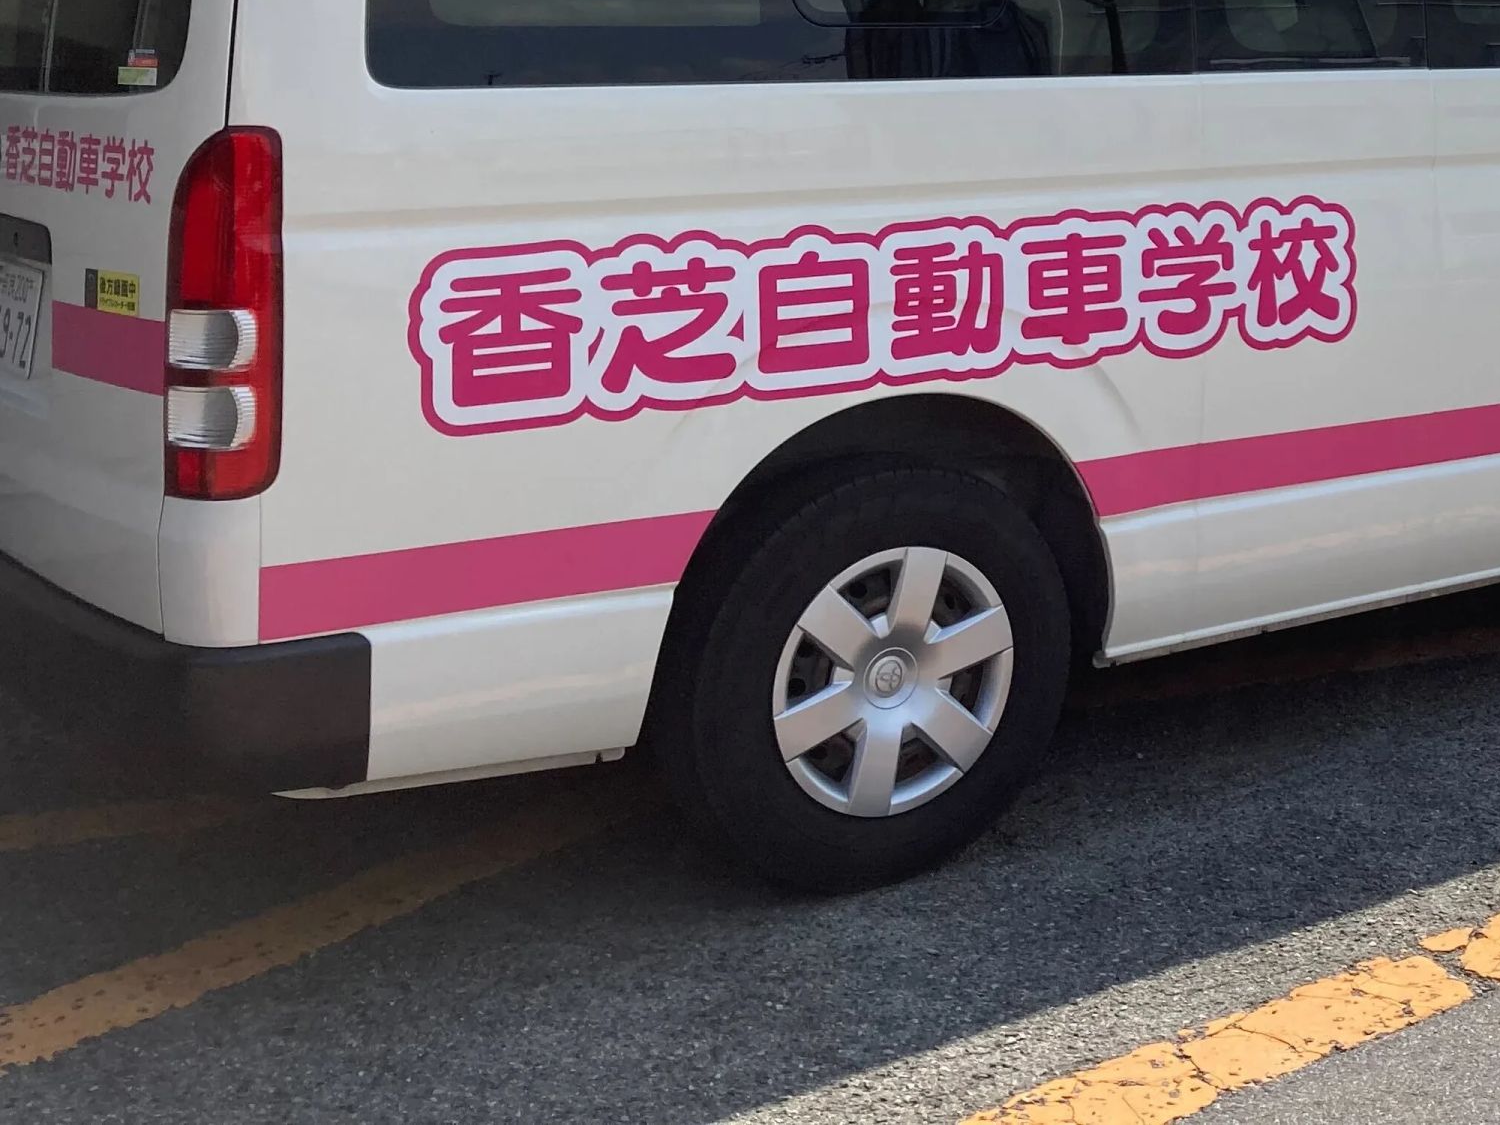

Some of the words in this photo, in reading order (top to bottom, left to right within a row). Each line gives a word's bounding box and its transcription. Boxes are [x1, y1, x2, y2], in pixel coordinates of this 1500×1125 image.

[5, 125, 155, 205] 香芝自動車学校
[0, 306, 32, 369] 9-72
[438, 218, 1344, 410] 香芝自動車学校
